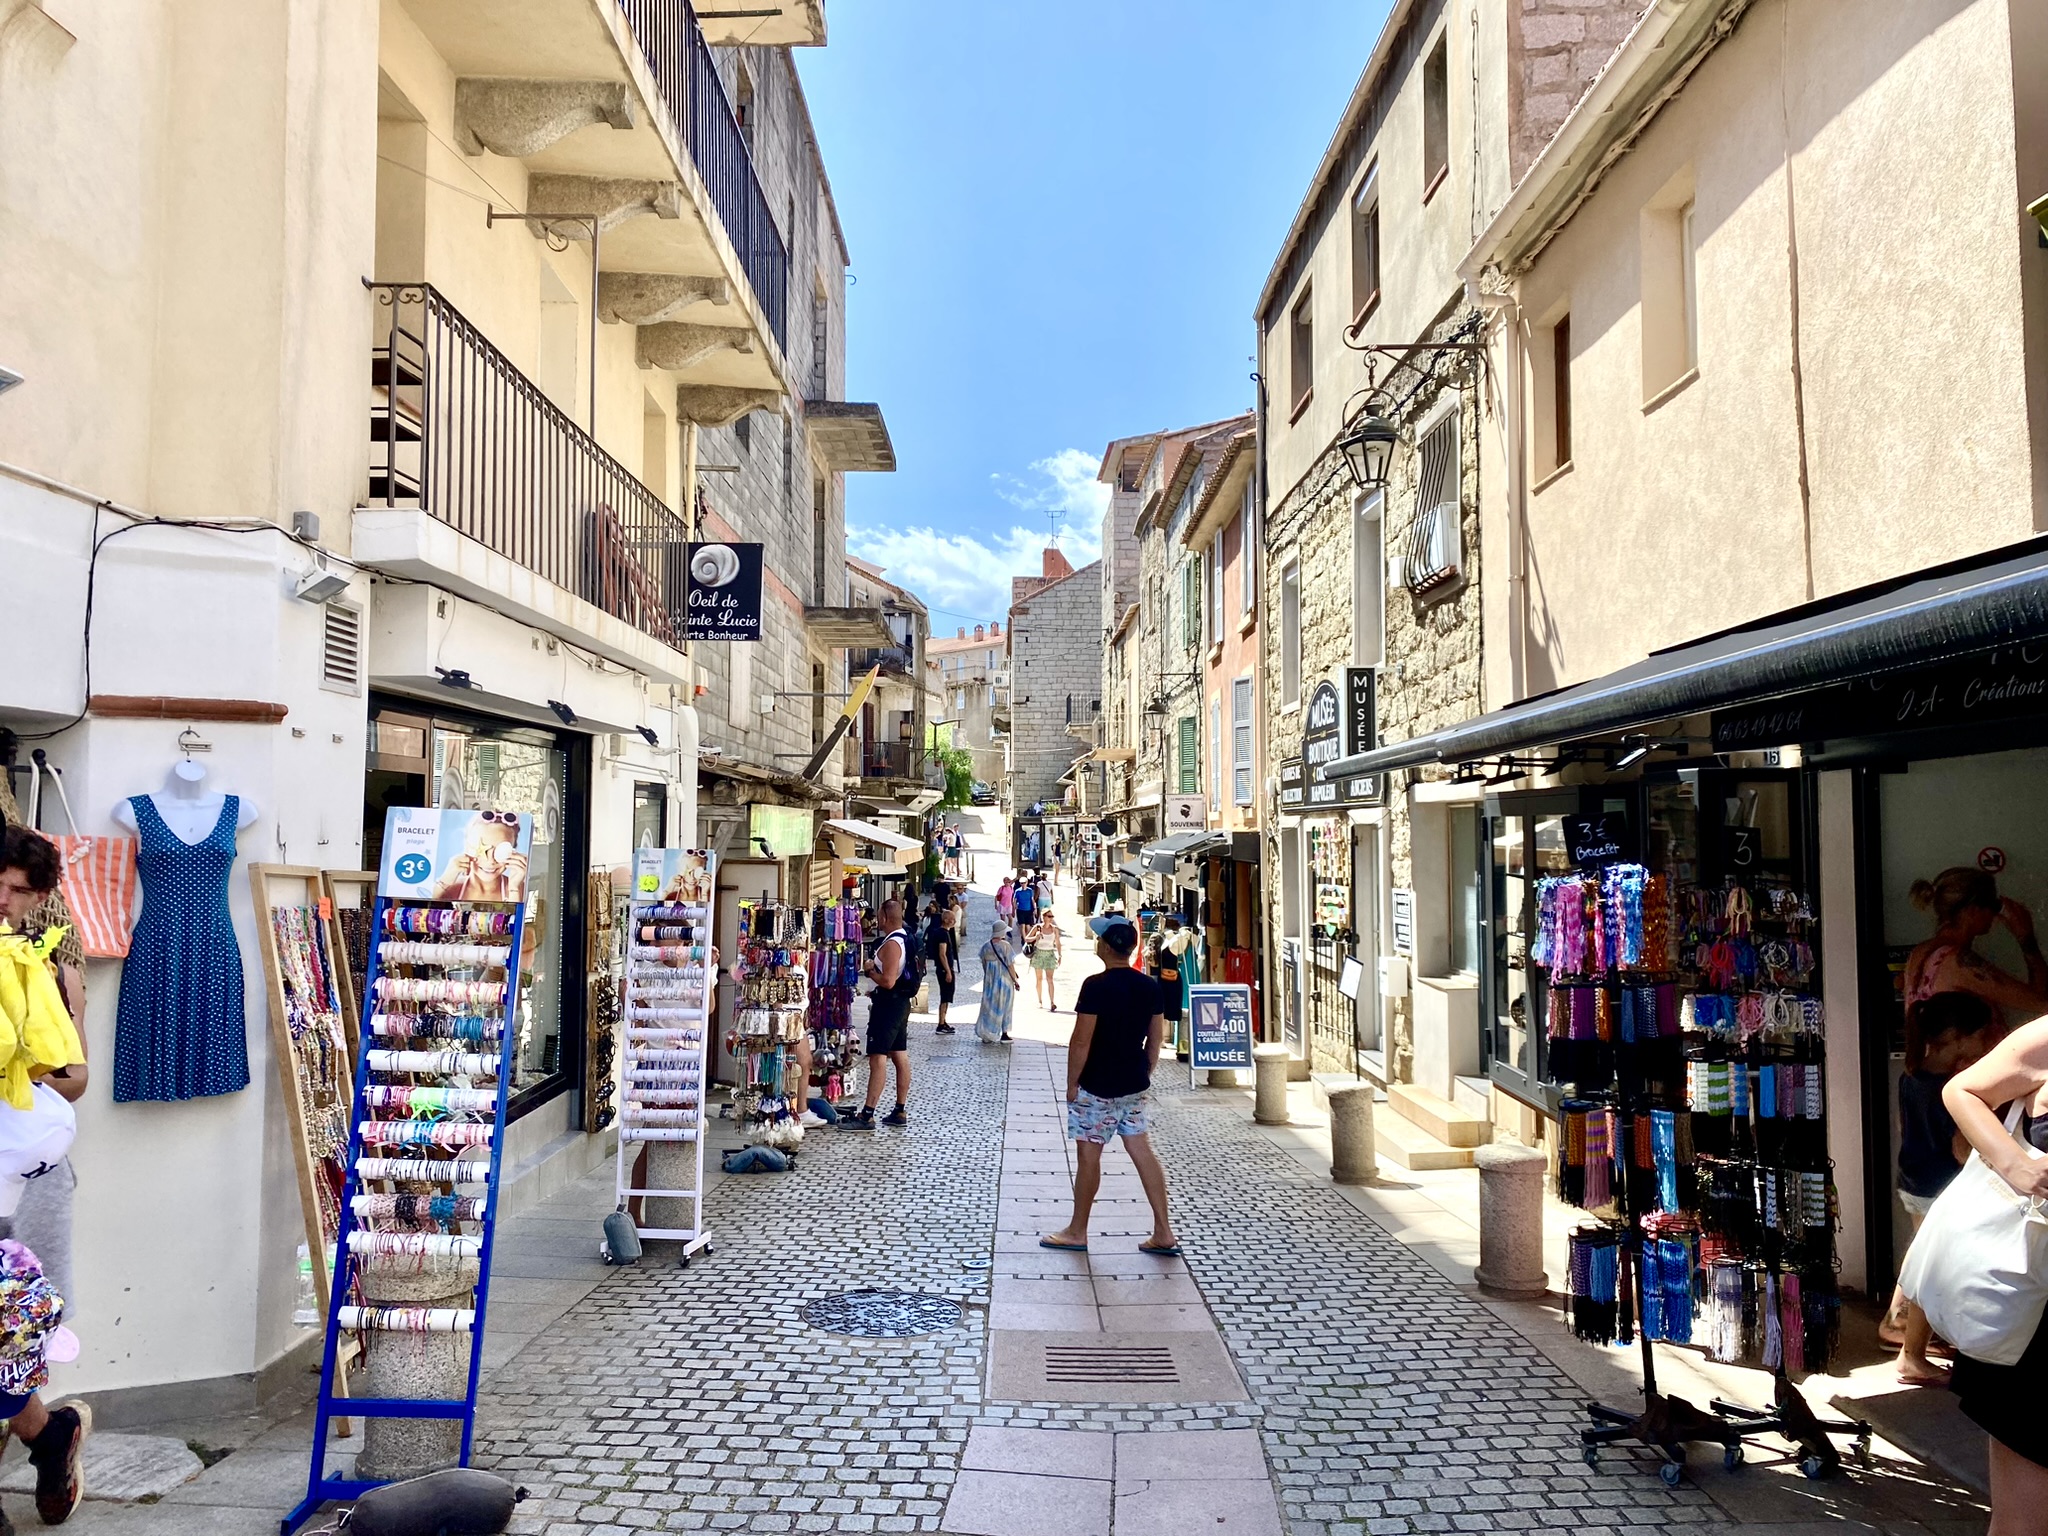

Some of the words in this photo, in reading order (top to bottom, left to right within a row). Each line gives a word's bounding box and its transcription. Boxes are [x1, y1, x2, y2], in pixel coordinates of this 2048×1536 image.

[689, 589, 718, 607] Oeil
[721, 594, 739, 608] de
[717, 609, 758, 627] Lucie
[708, 630, 748, 640] Bonheur
[1963, 673, 2047, 709] Créations
[1311, 692, 1335, 729] MUSÉE
[1354, 676, 1367, 753] MUSÉE
[1308, 737, 1339, 765] BOUTIQUE
[397, 826, 435, 836] BRACELET
[1575, 843, 1620, 861] Bracelet
[1220, 1019, 1246, 1033] 400
[1197, 1049, 1246, 1061] MUSÉE
